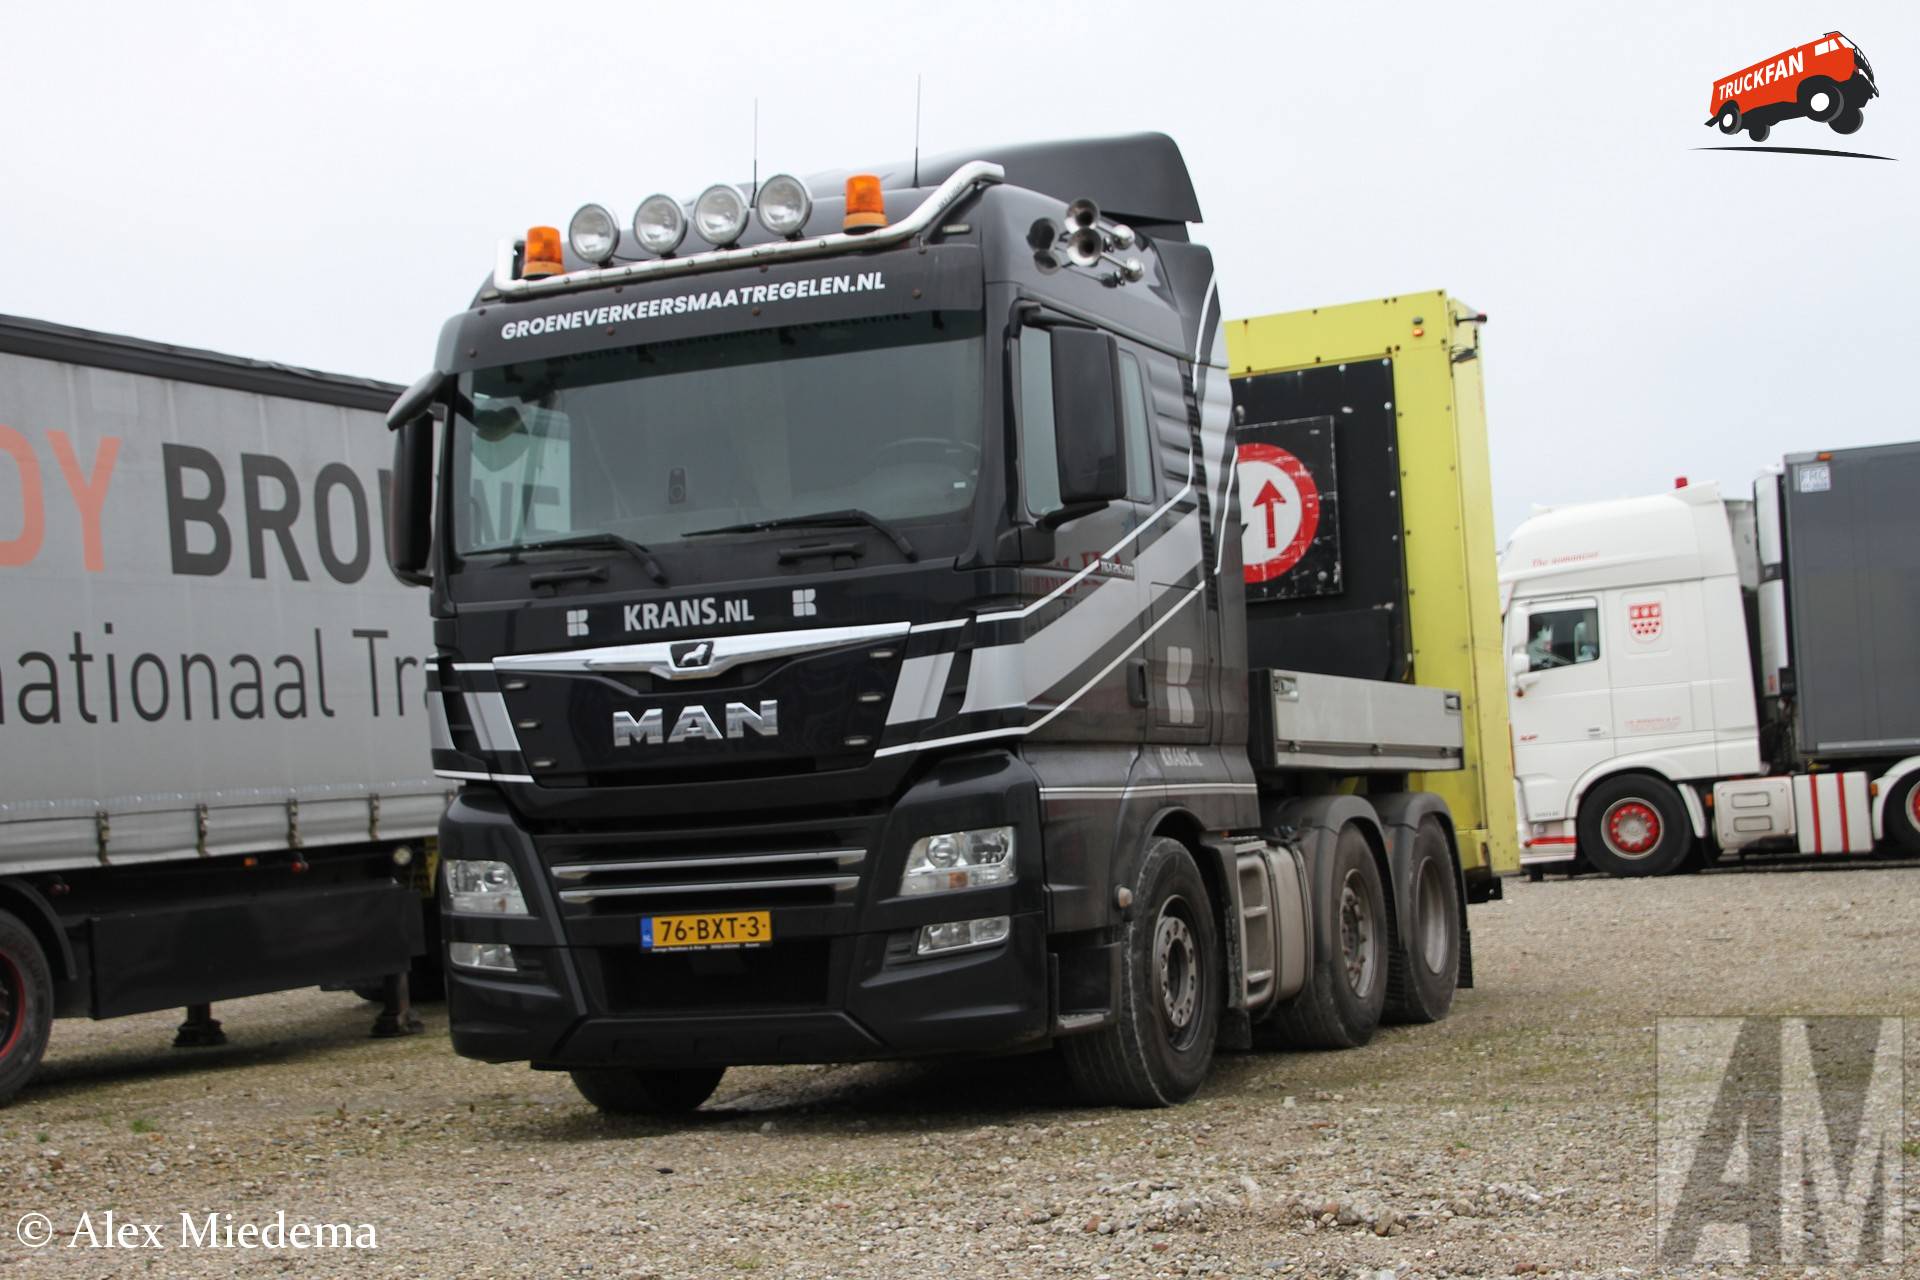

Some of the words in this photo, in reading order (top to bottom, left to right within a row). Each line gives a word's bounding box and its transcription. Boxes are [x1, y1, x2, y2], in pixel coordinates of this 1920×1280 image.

[501, 271, 886, 341] GROENEVERKEERSMAATREGELEN.NL
[623, 597, 755, 632] KRANS.NL
[0, 622, 335, 725] ationaal
[352, 629, 429, 718] Tr
[613, 699, 779, 747] MAN
[660, 916, 760, 942] 76-BXT-3
